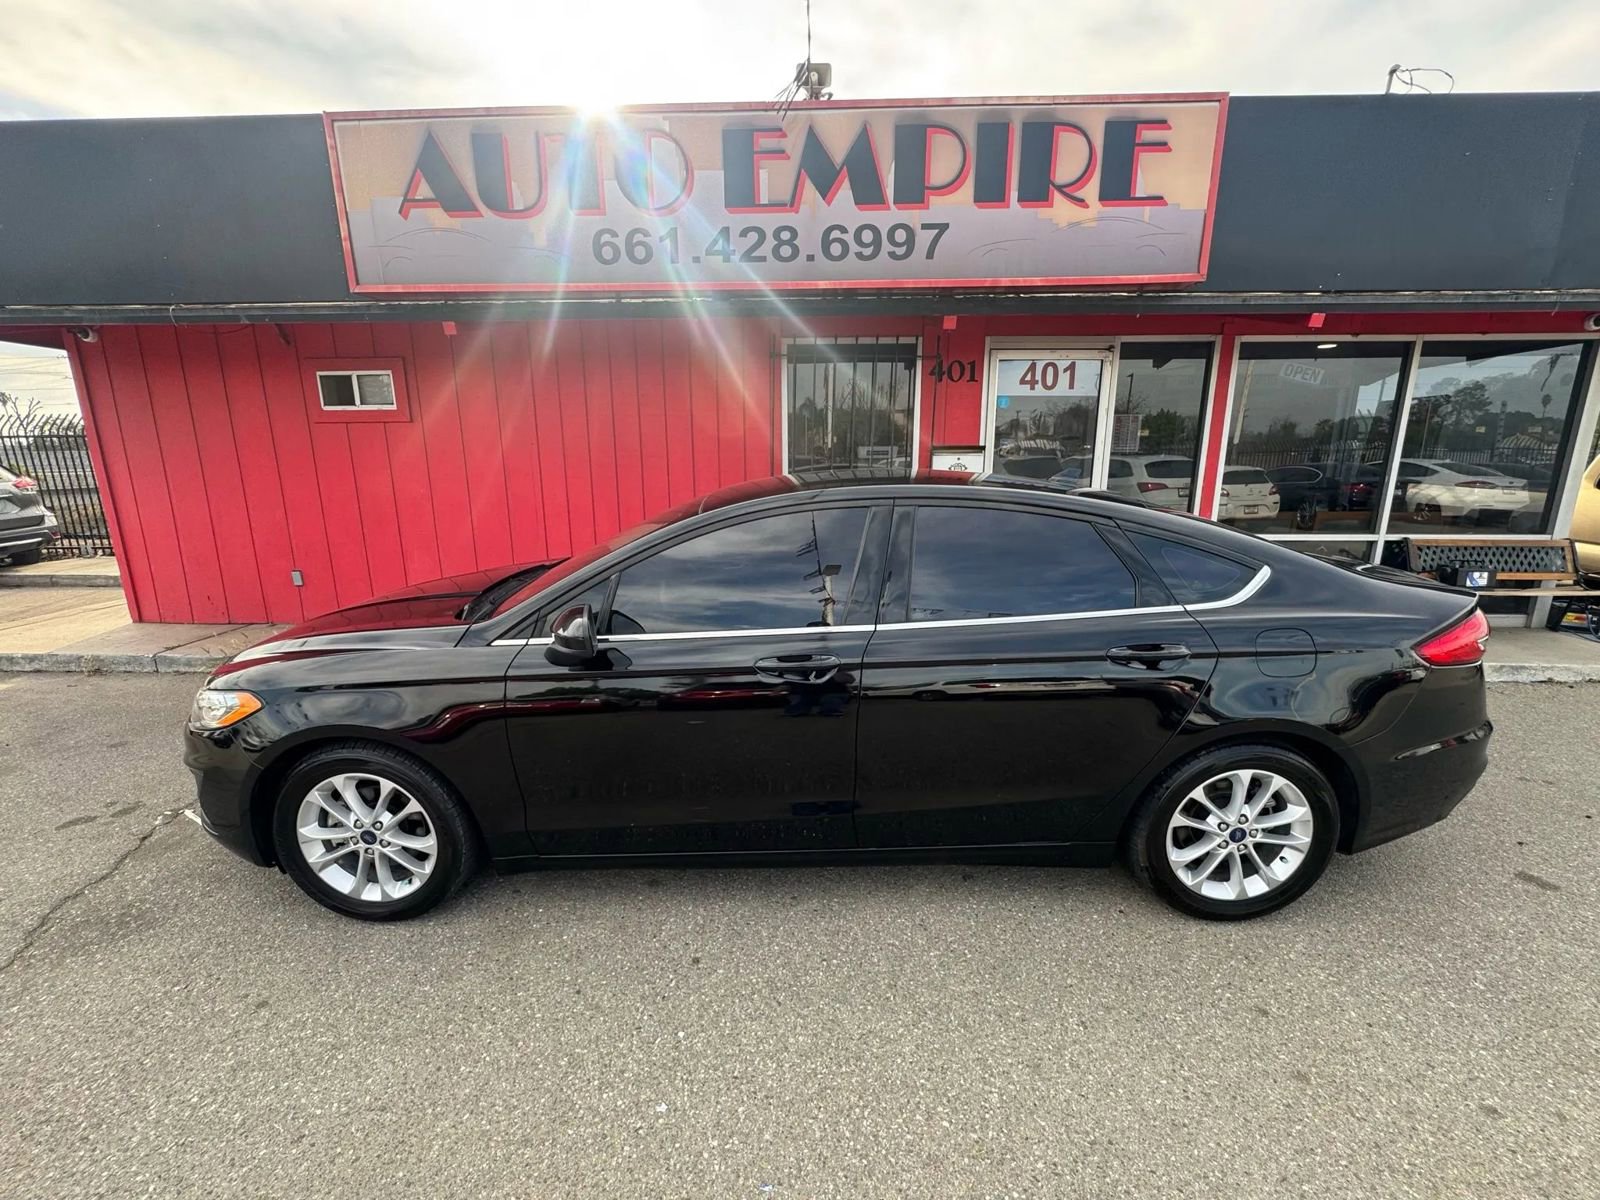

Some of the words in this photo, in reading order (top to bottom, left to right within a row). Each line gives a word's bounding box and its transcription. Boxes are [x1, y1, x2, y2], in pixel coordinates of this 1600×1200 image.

[398, 128, 695, 219] AUTO
[722, 118, 1173, 214] EMPIRE
[592, 222, 951, 266] 661.428.6997
[929, 360, 979, 383] 401
[1019, 361, 1077, 391] 401
[1283, 363, 1322, 384] OPEN
